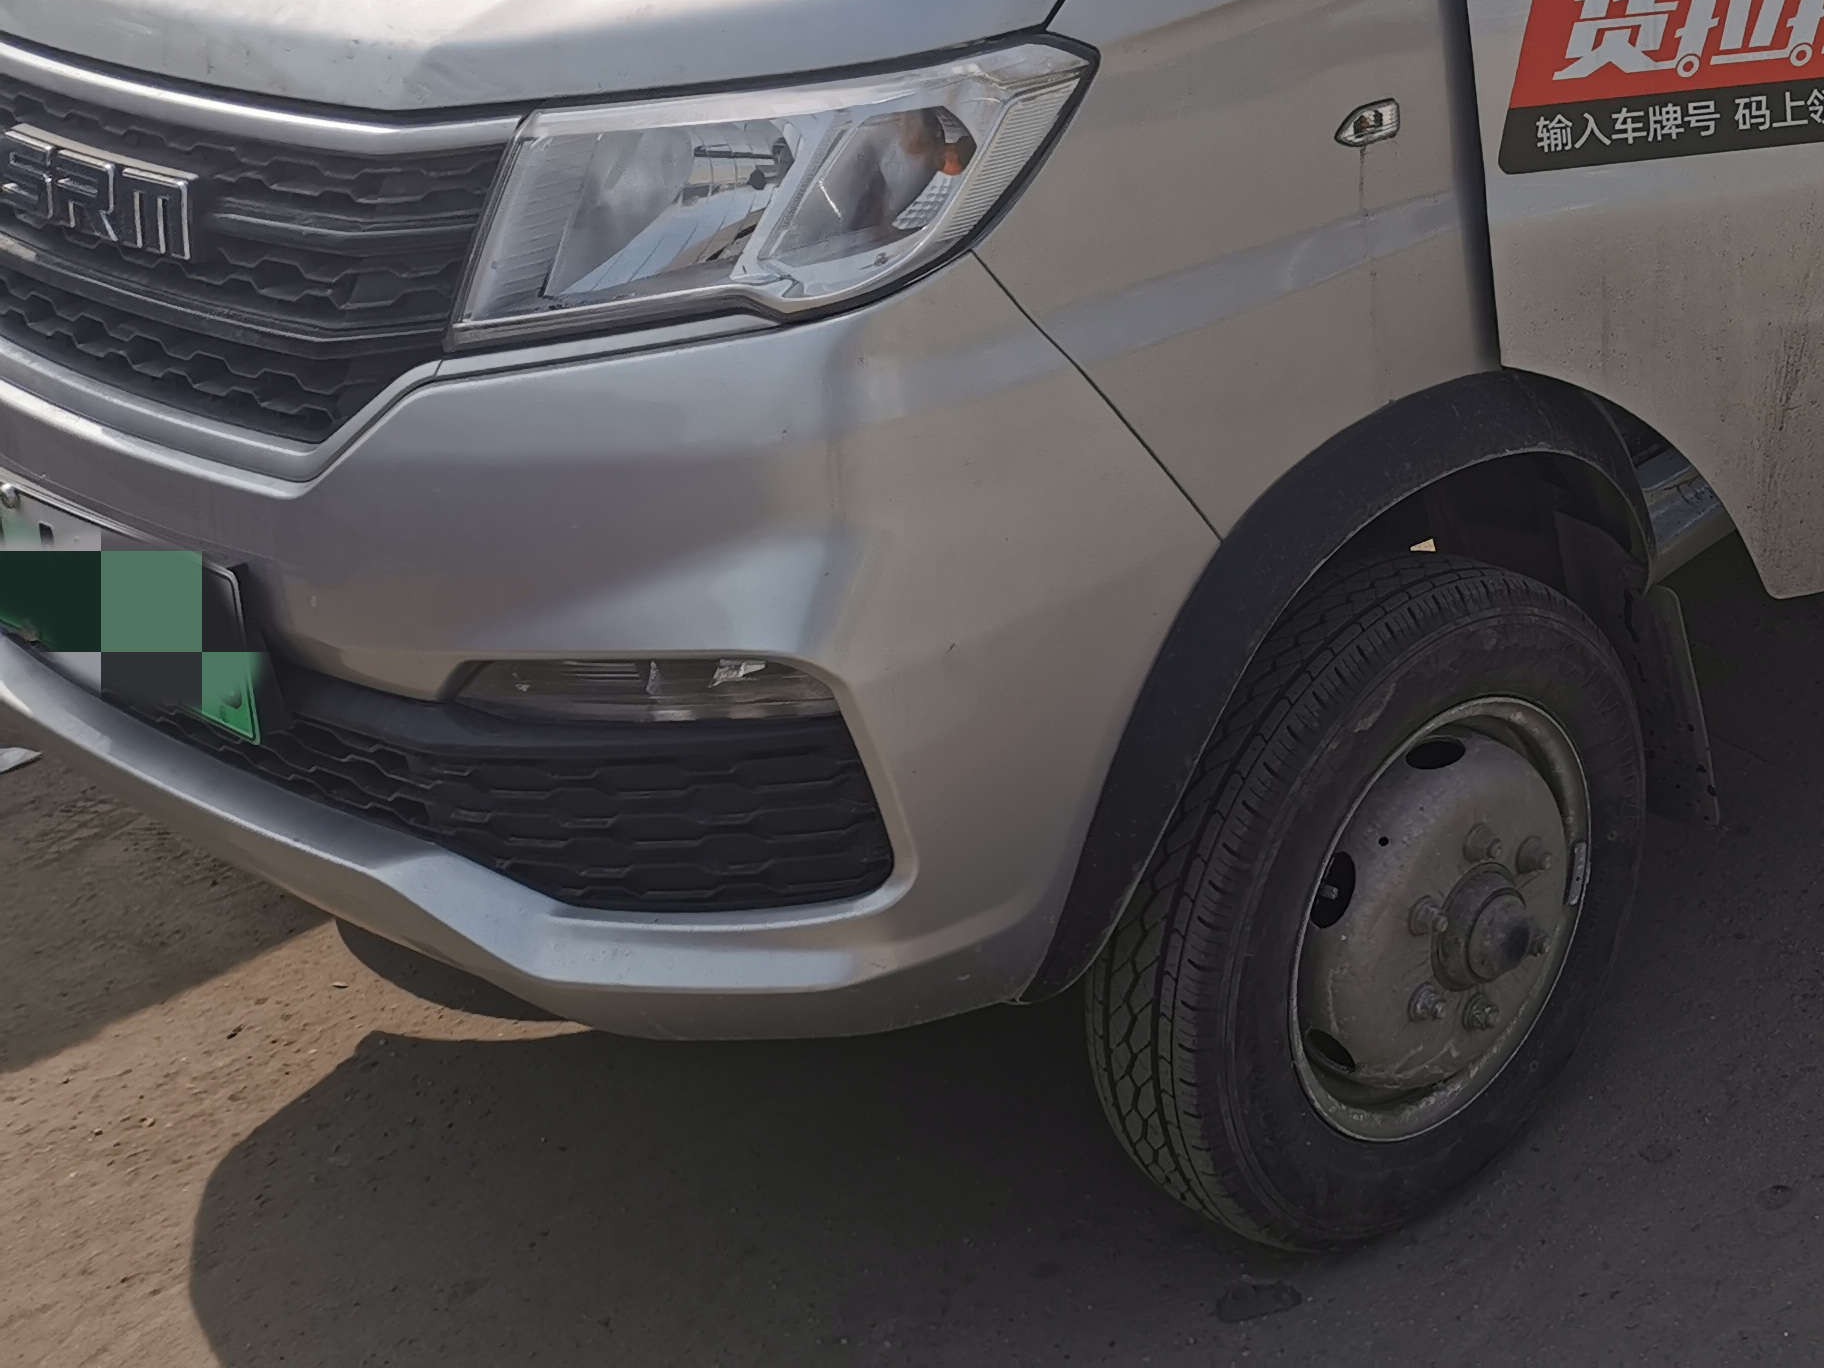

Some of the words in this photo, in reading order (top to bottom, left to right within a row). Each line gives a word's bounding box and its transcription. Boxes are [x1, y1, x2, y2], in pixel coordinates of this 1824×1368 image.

[1535, 98, 1721, 154] 输入车牌号
